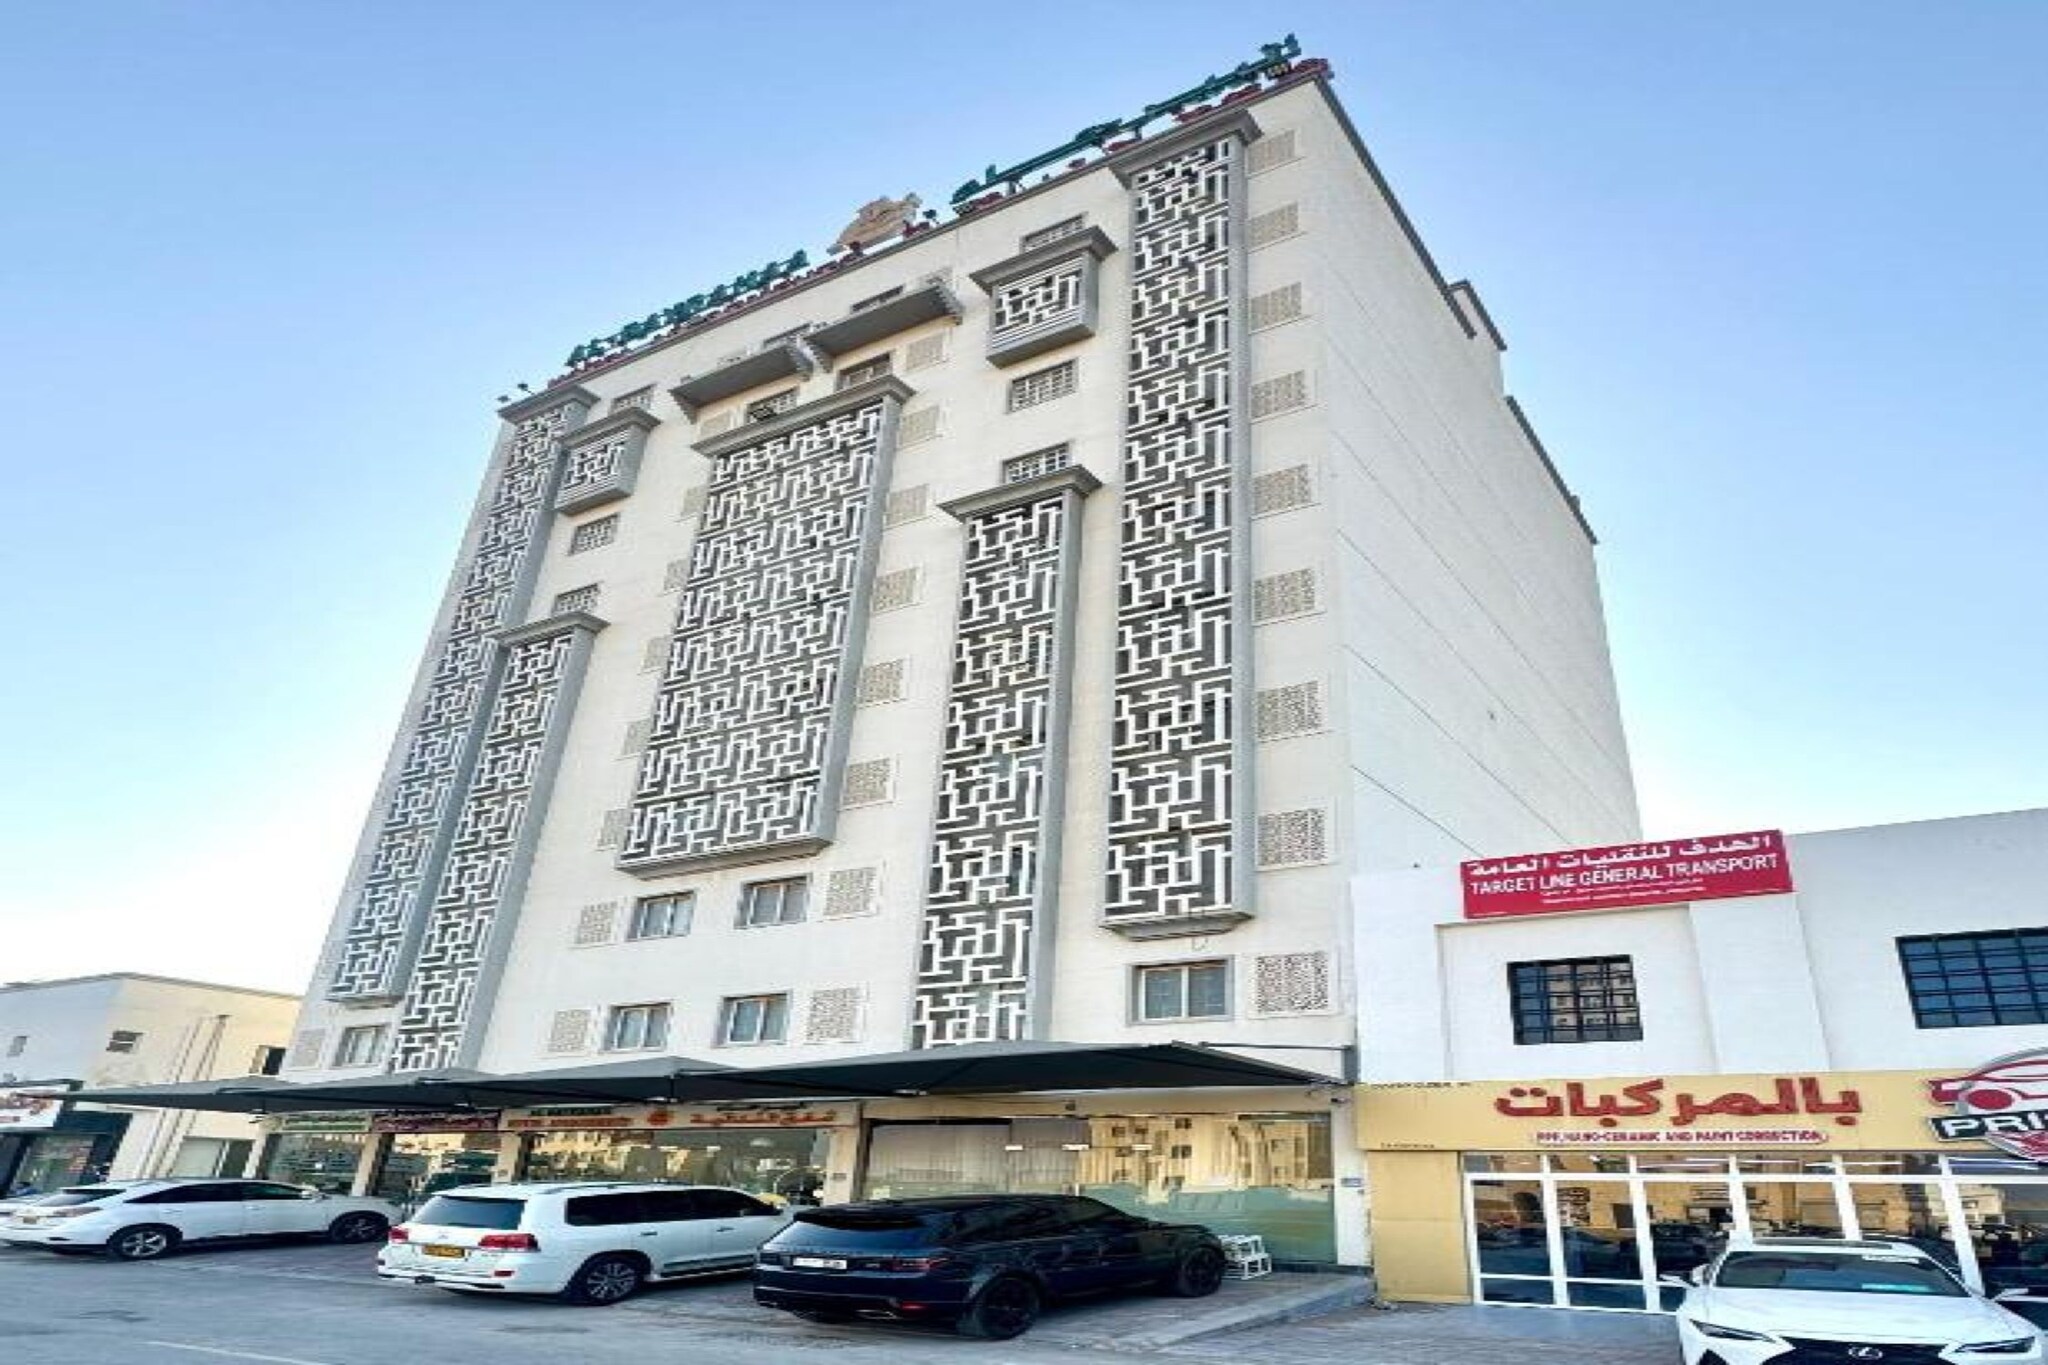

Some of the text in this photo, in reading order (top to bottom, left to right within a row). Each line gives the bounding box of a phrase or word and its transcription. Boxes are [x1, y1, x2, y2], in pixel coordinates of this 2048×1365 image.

[1679, 834, 1770, 856] الهدف
[1467, 857, 1549, 876] العامة
[1470, 877, 1535, 895] TARGET
[1540, 873, 1575, 890] LINE
[1580, 865, 1664, 886] GENERAL
[1666, 853, 1777, 877] TRANSPORT
[1494, 1077, 1862, 1127] بالمركبات
[1941, 1111, 2048, 1138] PRI
